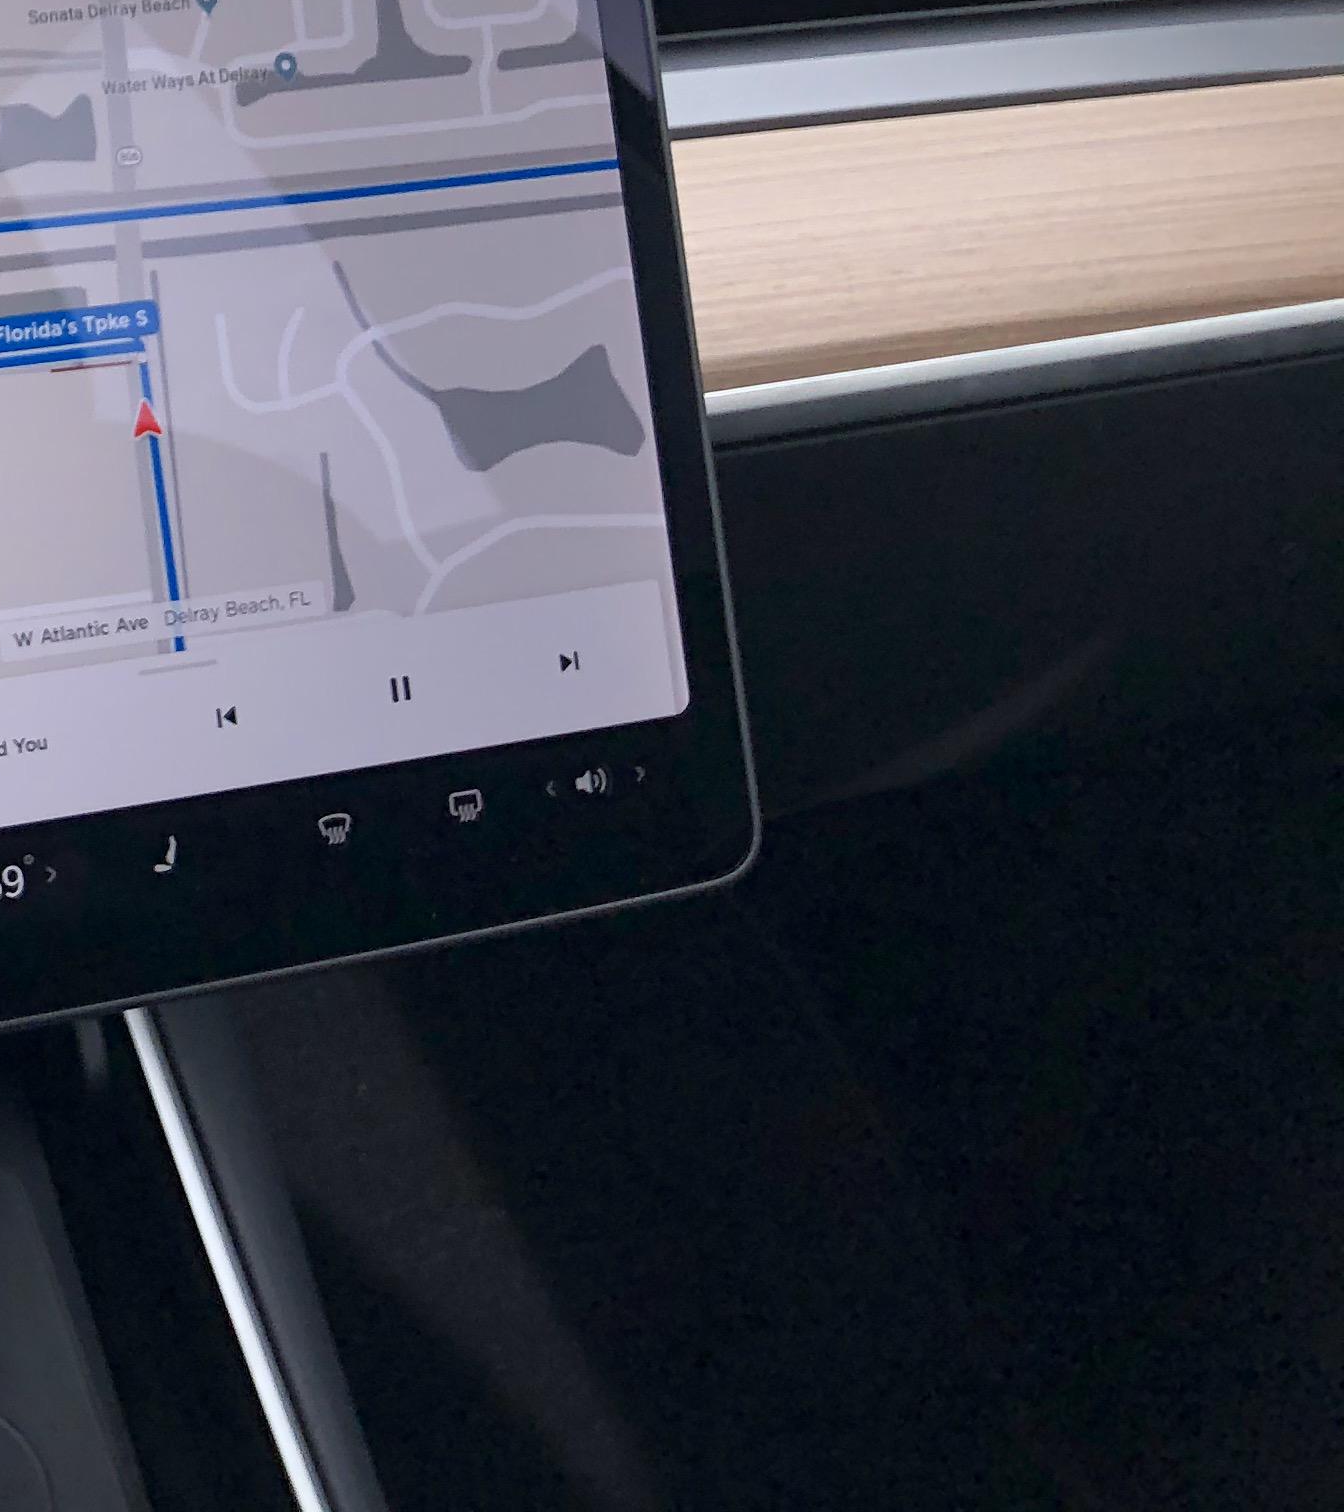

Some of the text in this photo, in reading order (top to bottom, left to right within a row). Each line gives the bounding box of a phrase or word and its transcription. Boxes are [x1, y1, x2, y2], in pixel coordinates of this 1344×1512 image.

[27, 7, 84, 25] Sonata
[88, 0, 137, 20] Delray
[102, 66, 269, 95] Water Ways At Delray
[82, 313, 132, 338] Tpke
[135, 313, 149, 329] S
[164, 590, 312, 627] Delray Beach, FL
[13, 615, 149, 647] W Atlantic Ave
[13, 735, 49, 754] You
